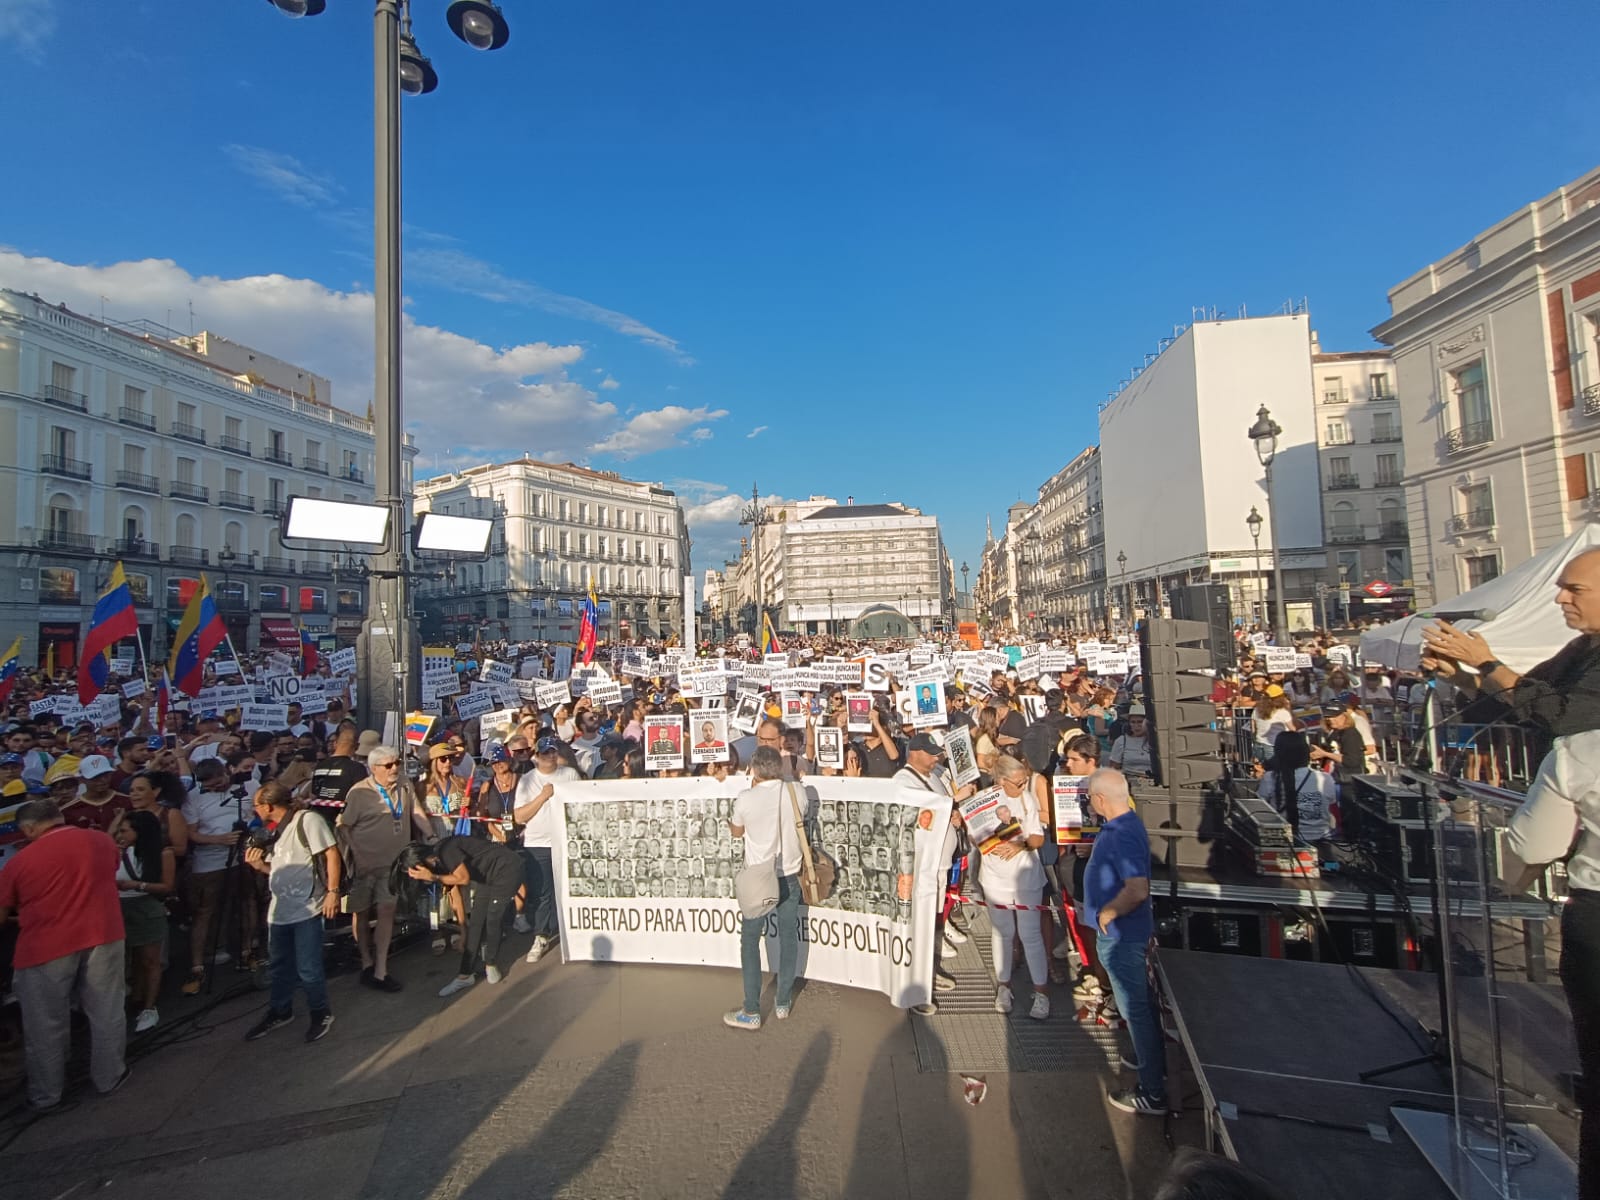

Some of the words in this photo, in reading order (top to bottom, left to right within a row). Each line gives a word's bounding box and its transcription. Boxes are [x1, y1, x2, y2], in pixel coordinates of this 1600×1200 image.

[868, 663, 886, 684] S
[271, 677, 300, 697] NO
[569, 907, 641, 931] LIBERTAD
[645, 908, 687, 932] PARA
[688, 908, 743, 935] TODOS
[796, 916, 840, 948] RESOS
